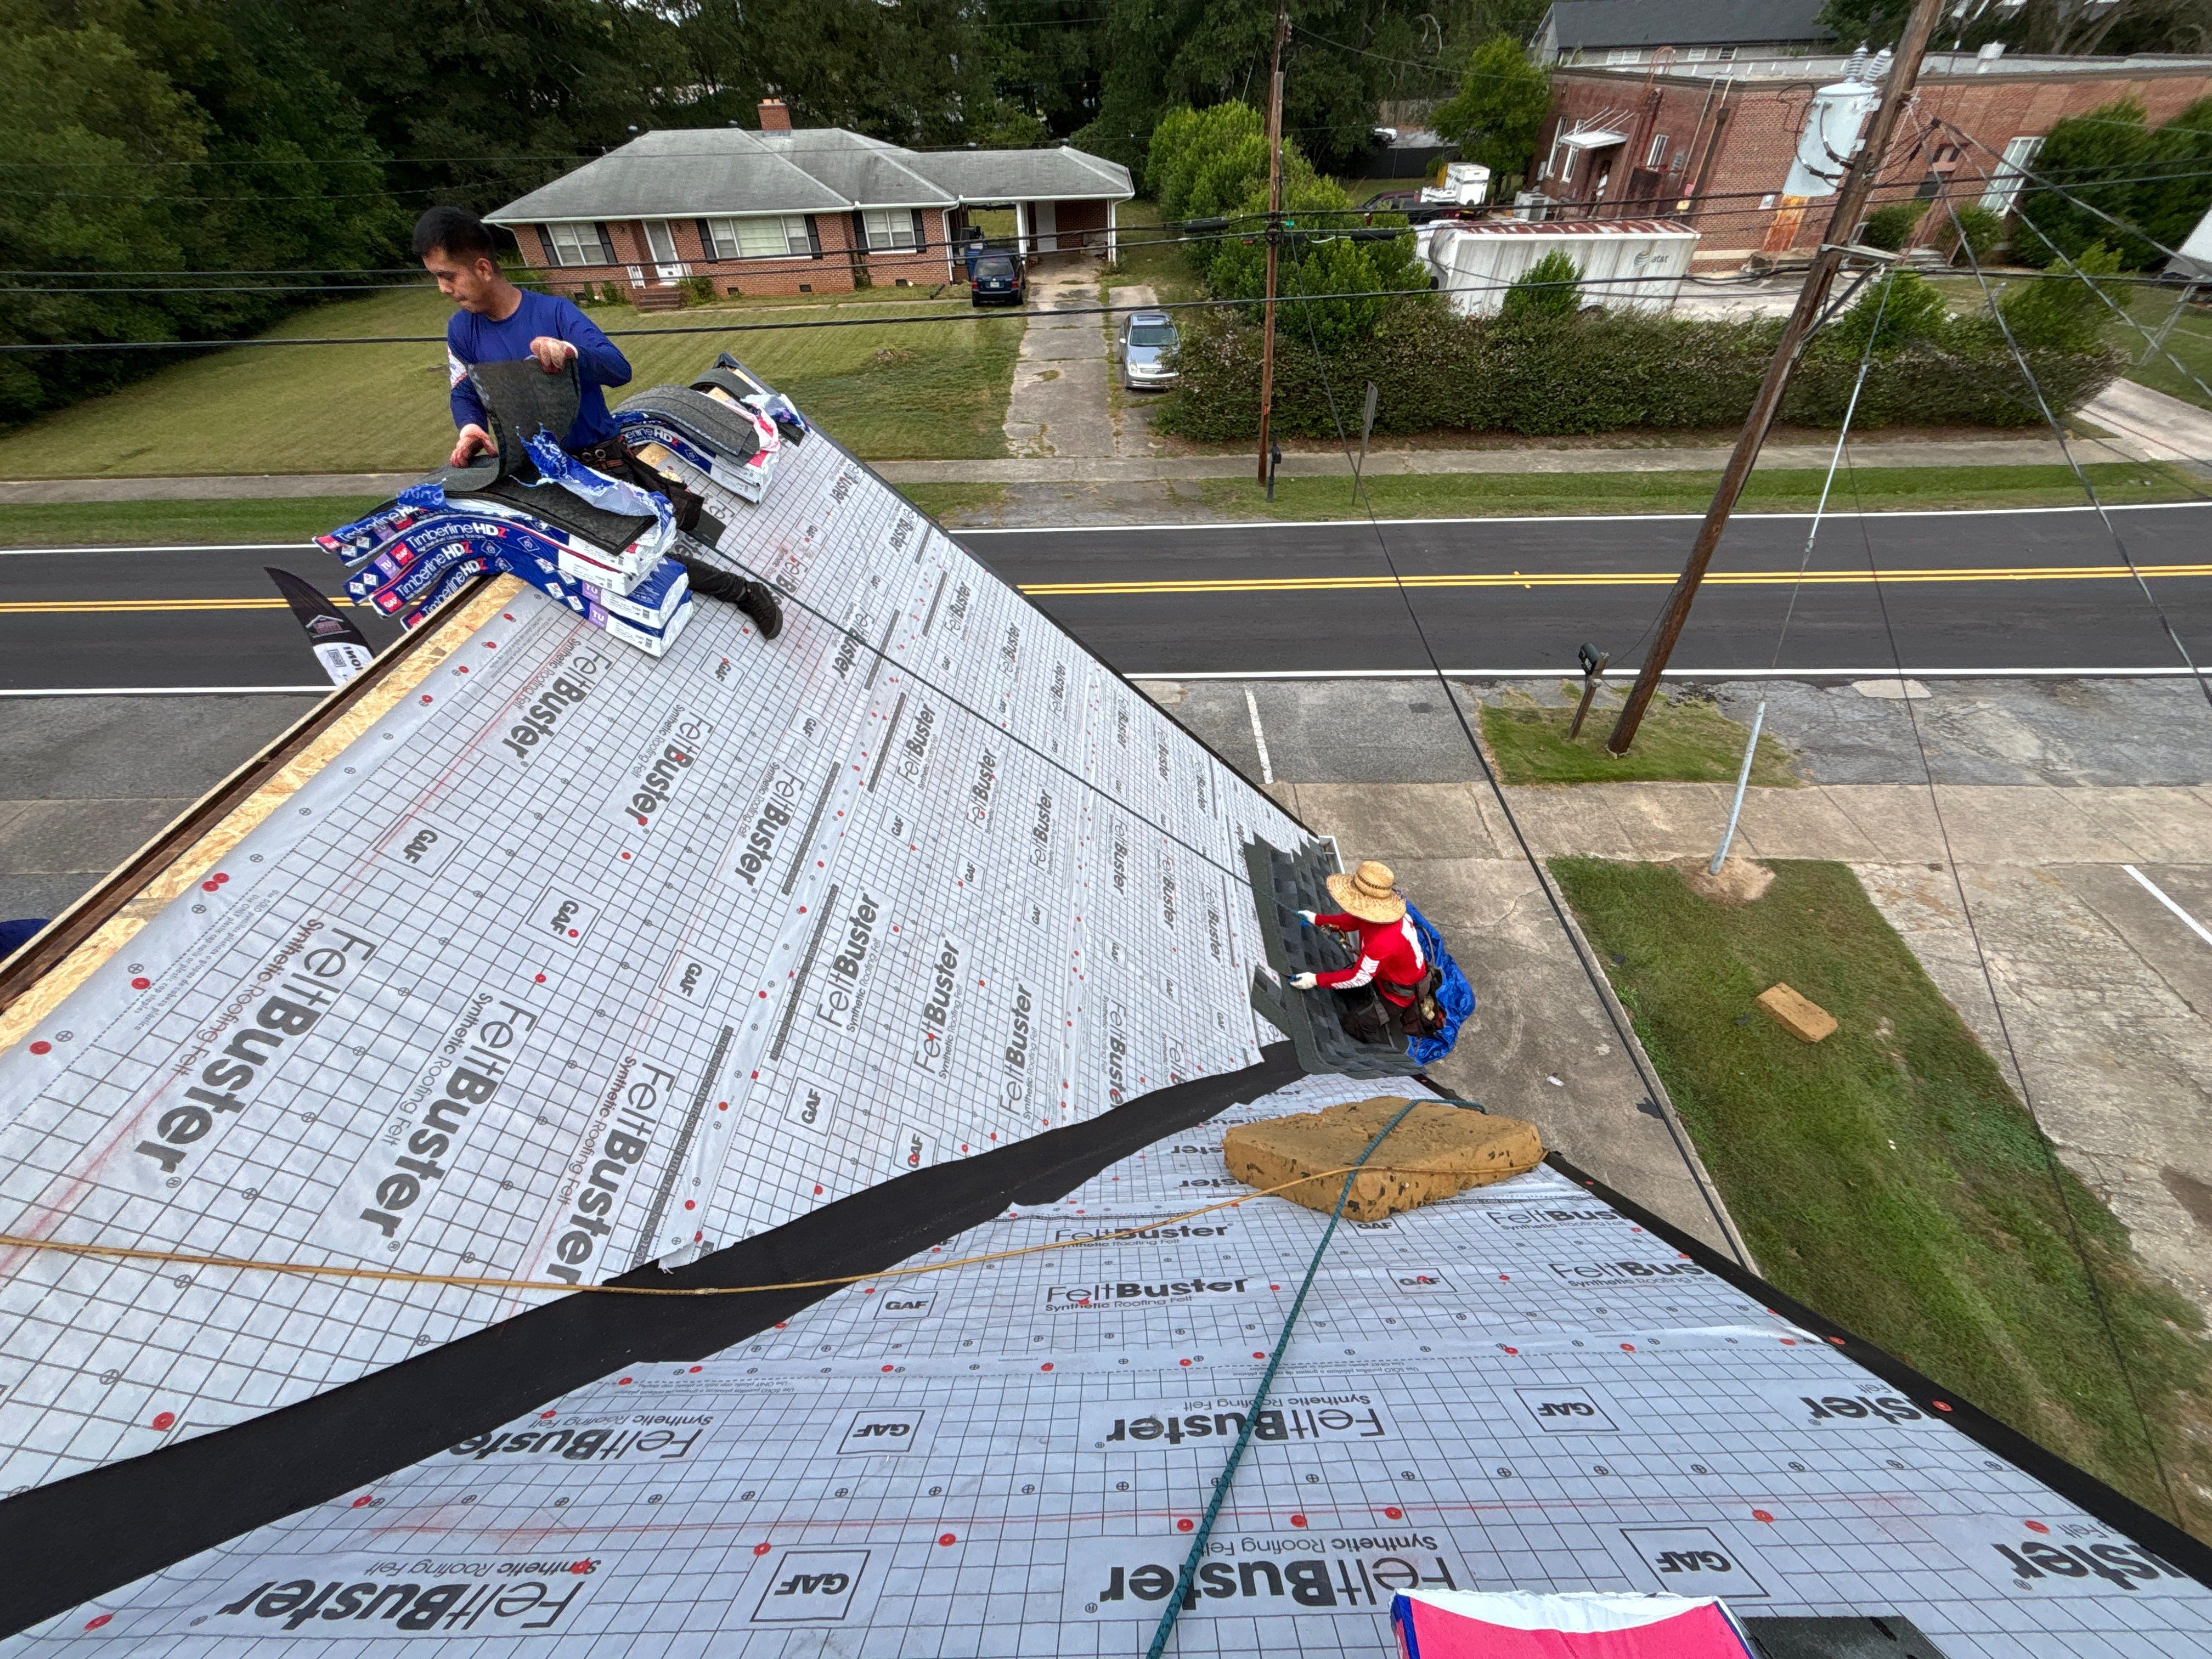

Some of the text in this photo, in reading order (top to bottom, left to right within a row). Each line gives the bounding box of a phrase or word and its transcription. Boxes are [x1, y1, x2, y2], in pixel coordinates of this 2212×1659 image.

[1651, 255, 1668, 263] at&t
[380, 560, 393, 570] TU
[395, 548, 409, 560] GAF
[584, 582, 599, 594] TU
[771, 557, 808, 605] FeltBus
[383, 596, 398, 608] GAF
[592, 609, 605, 622] TU
[944, 581, 971, 637] FeltBuster
[941, 656, 951, 670] GAF
[998, 622, 1020, 679] FeltBuster
[513, 638, 582, 710] Synthetic Roofing Felt
[715, 662, 731, 682] GAF
[502, 646, 613, 759] FeltBuster
[999, 698, 1008, 713] GAF
[1048, 660, 1066, 719] FeltBuster
[630, 704, 685, 779] Synthetic Roofing Felt
[803, 718, 817, 738] GAF
[898, 702, 935, 785] FeltBuster
[624, 712, 713, 826] FeltBuster
[917, 761, 931, 790] Synthetic
[927, 744, 937, 764] Roofing
[737, 761, 780, 839] Synthetic Roofing Felt
[966, 748, 996, 830] FeltBuster
[735, 770, 805, 886] FeltBuster
[891, 815, 904, 837] GAF
[1029, 789, 1052, 871] FeltBuster
[403, 829, 438, 864] GAF
[1113, 817, 1127, 895] FeltBuster
[965, 861, 976, 883] GAF
[1162, 852, 1175, 931] FeltBuster
[217, 917, 235, 933] plastic
[233, 903, 250, 918] ONLY
[550, 900, 579, 935] GAF
[1032, 905, 1041, 925] GAF
[1206, 885, 1221, 964] FeltBuster
[205, 934, 218, 945] cap
[1111, 943, 1120, 963] GAF
[168, 962, 187, 983] plastic
[816, 893, 879, 1028] FeltBuster
[155, 983, 168, 994] cap
[171, 918, 325, 1076] Synthetic Roofing Felt
[679, 963, 702, 997] GAF
[847, 938, 882, 1032] Synthetic Roofing Felt
[913, 940, 960, 1074] FeltBuster
[1217, 1012, 1225, 1031] GAF
[134, 927, 377, 1173] FeltBuster
[939, 1035, 955, 1079] Synthetic
[949, 998, 962, 1034] Roofing
[1000, 983, 1032, 1115] FeltBuster
[1109, 1000, 1127, 1108] FeltBuste
[381, 992, 494, 1146] Synthetic Roofing Felt
[1028, 1042, 1039, 1076] Roofing
[802, 1088, 821, 1124] GAF
[1023, 1077, 1034, 1120] Synthetic
[359, 1000, 538, 1239] FeltBuster
[556, 1056, 637, 1206] Synthetic Roofing Felt
[546, 1062, 676, 1285] FeltBuster
[1357, 1222, 1393, 1230] GAF
[1113, 1239, 1158, 1248] Roofing
[1047, 1278, 1249, 1304] FeltBuster
[1400, 1277, 1441, 1286] GAF
[1568, 1278, 1636, 1288] Synthetic
[1638, 1276, 1686, 1286] Roofing
[885, 1300, 929, 1310] GAF
[1045, 1295, 1193, 1312] Synthetic Roofing Felt
[1183, 1395, 1371, 1412] Synthetic Roofing Felt
[1537, 1402, 1595, 1418] GAF
[529, 1414, 714, 1429] Synthetic Roofing Felt
[853, 1423, 911, 1438] GAF
[1105, 1408, 1385, 1444] FeltBuster
[448, 1429, 704, 1460] FeltBuste
[1201, 1533, 1438, 1557] Synthetic Roofing Felt
[1655, 1550, 1731, 1573] GAF
[366, 1557, 601, 1577] Snthetic Roofing Felt
[774, 1572, 850, 1596] GAF
[215, 1578, 585, 1630] FeltBuster
